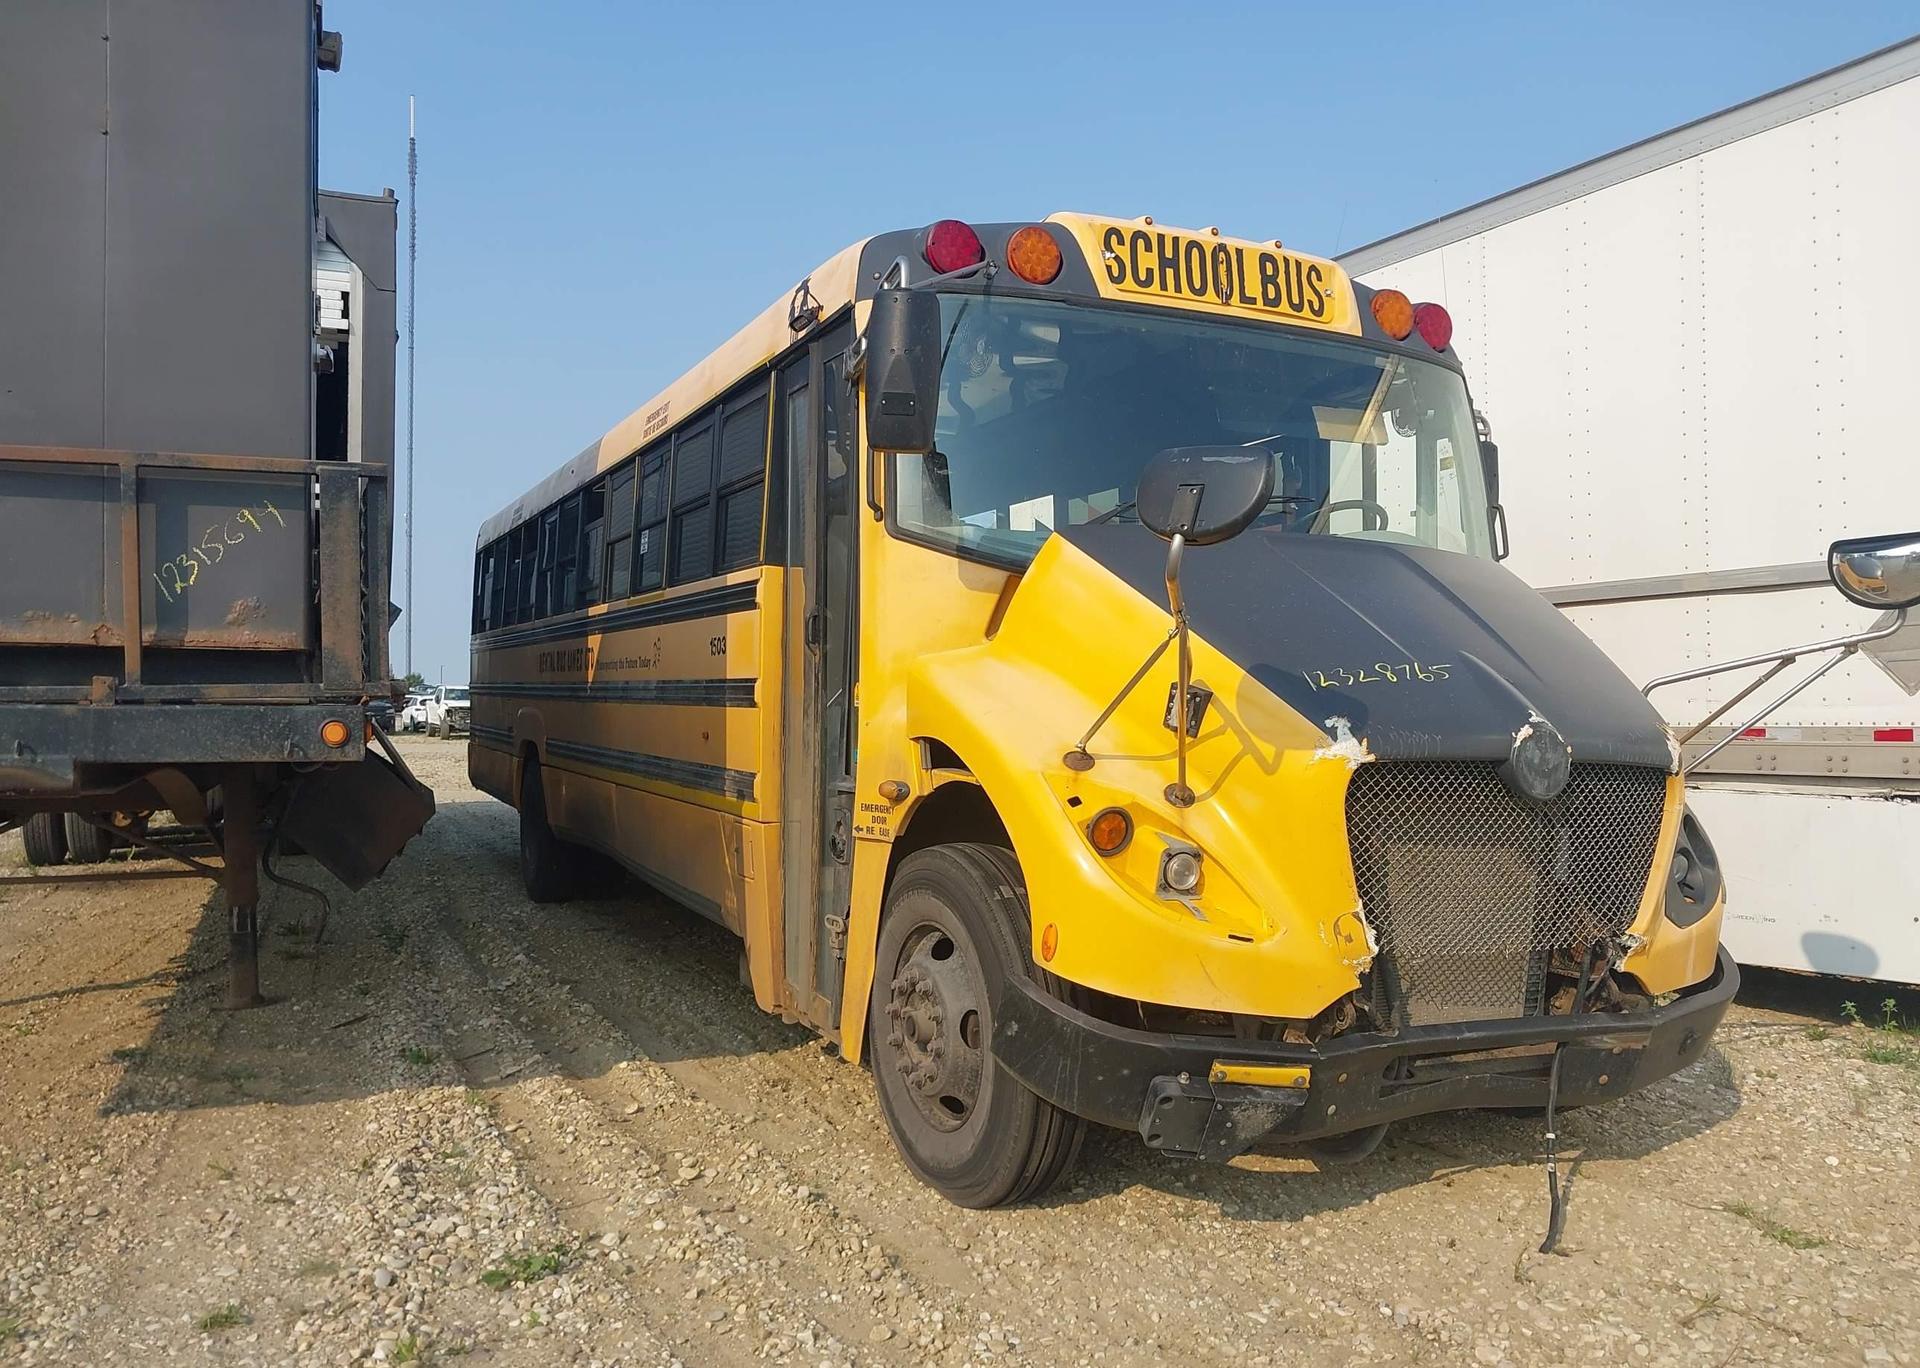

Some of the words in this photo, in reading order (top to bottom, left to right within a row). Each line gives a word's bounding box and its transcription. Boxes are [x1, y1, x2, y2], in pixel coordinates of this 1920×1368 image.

[153, 500, 287, 602] 12315694
[709, 636, 727, 656] 1503
[1302, 662, 1453, 691] 12328765
